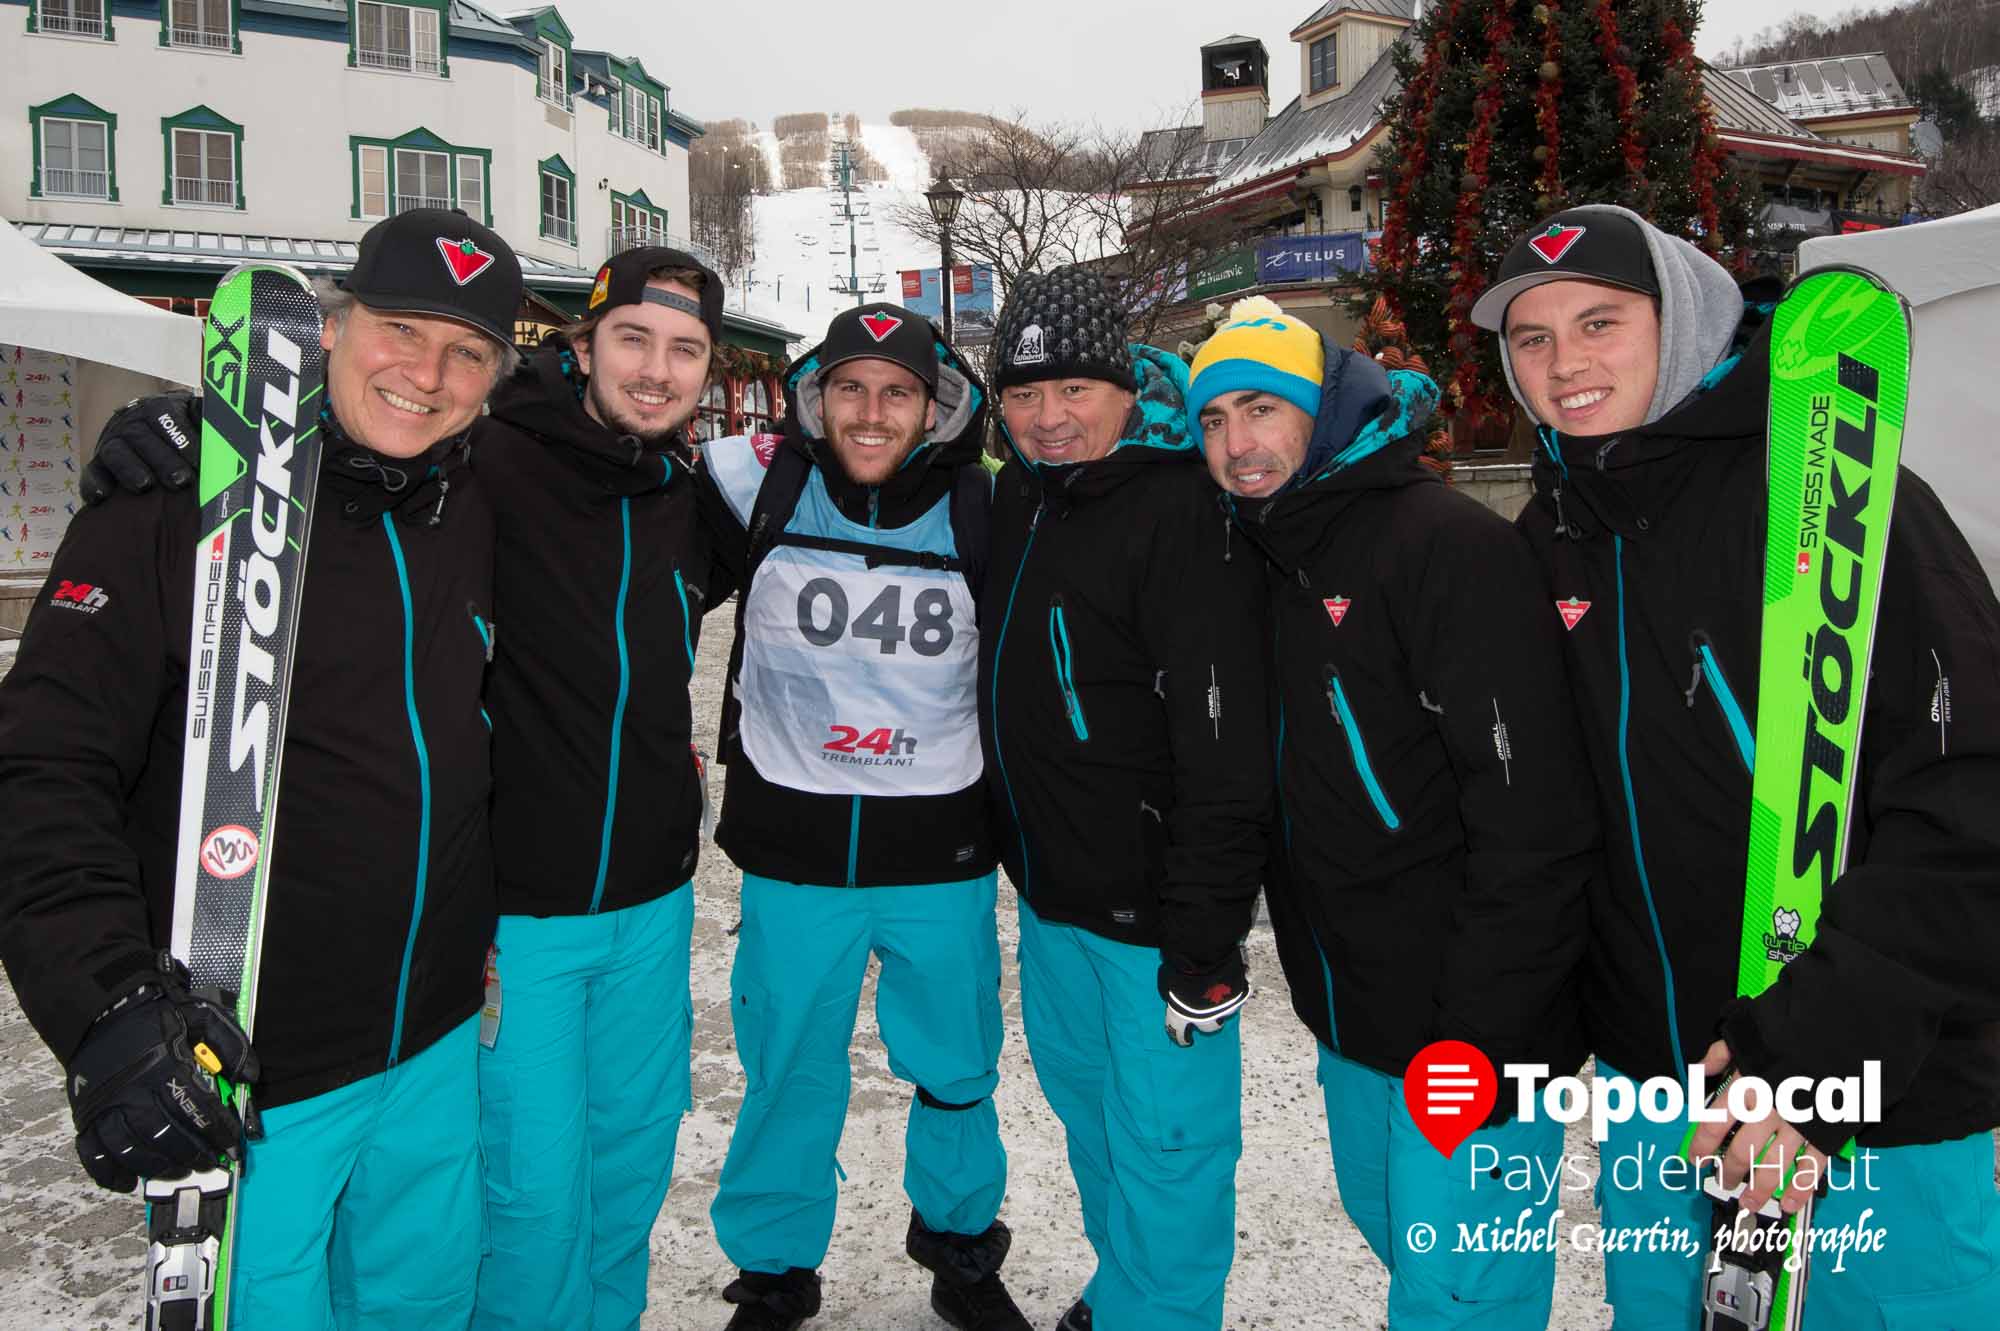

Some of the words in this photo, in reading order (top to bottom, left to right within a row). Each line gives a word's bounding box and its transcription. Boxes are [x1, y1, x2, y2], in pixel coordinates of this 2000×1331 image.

[1294, 249, 1345, 263] TELUS
[207, 313, 245, 408] SX
[1808, 395, 1830, 468] MADE
[1801, 472, 1824, 549] SWISS
[54, 579, 109, 608] 24h
[202, 561, 223, 644] MADE
[228, 327, 301, 813] STÖCKLI
[797, 577, 954, 657] 048
[1793, 352, 1879, 900] STÖCKLI
[193, 648, 213, 739] SWISS
[821, 752, 916, 767] TREMBLANT
[822, 724, 918, 756] 24h
[1763, 934, 1806, 953] turtle
